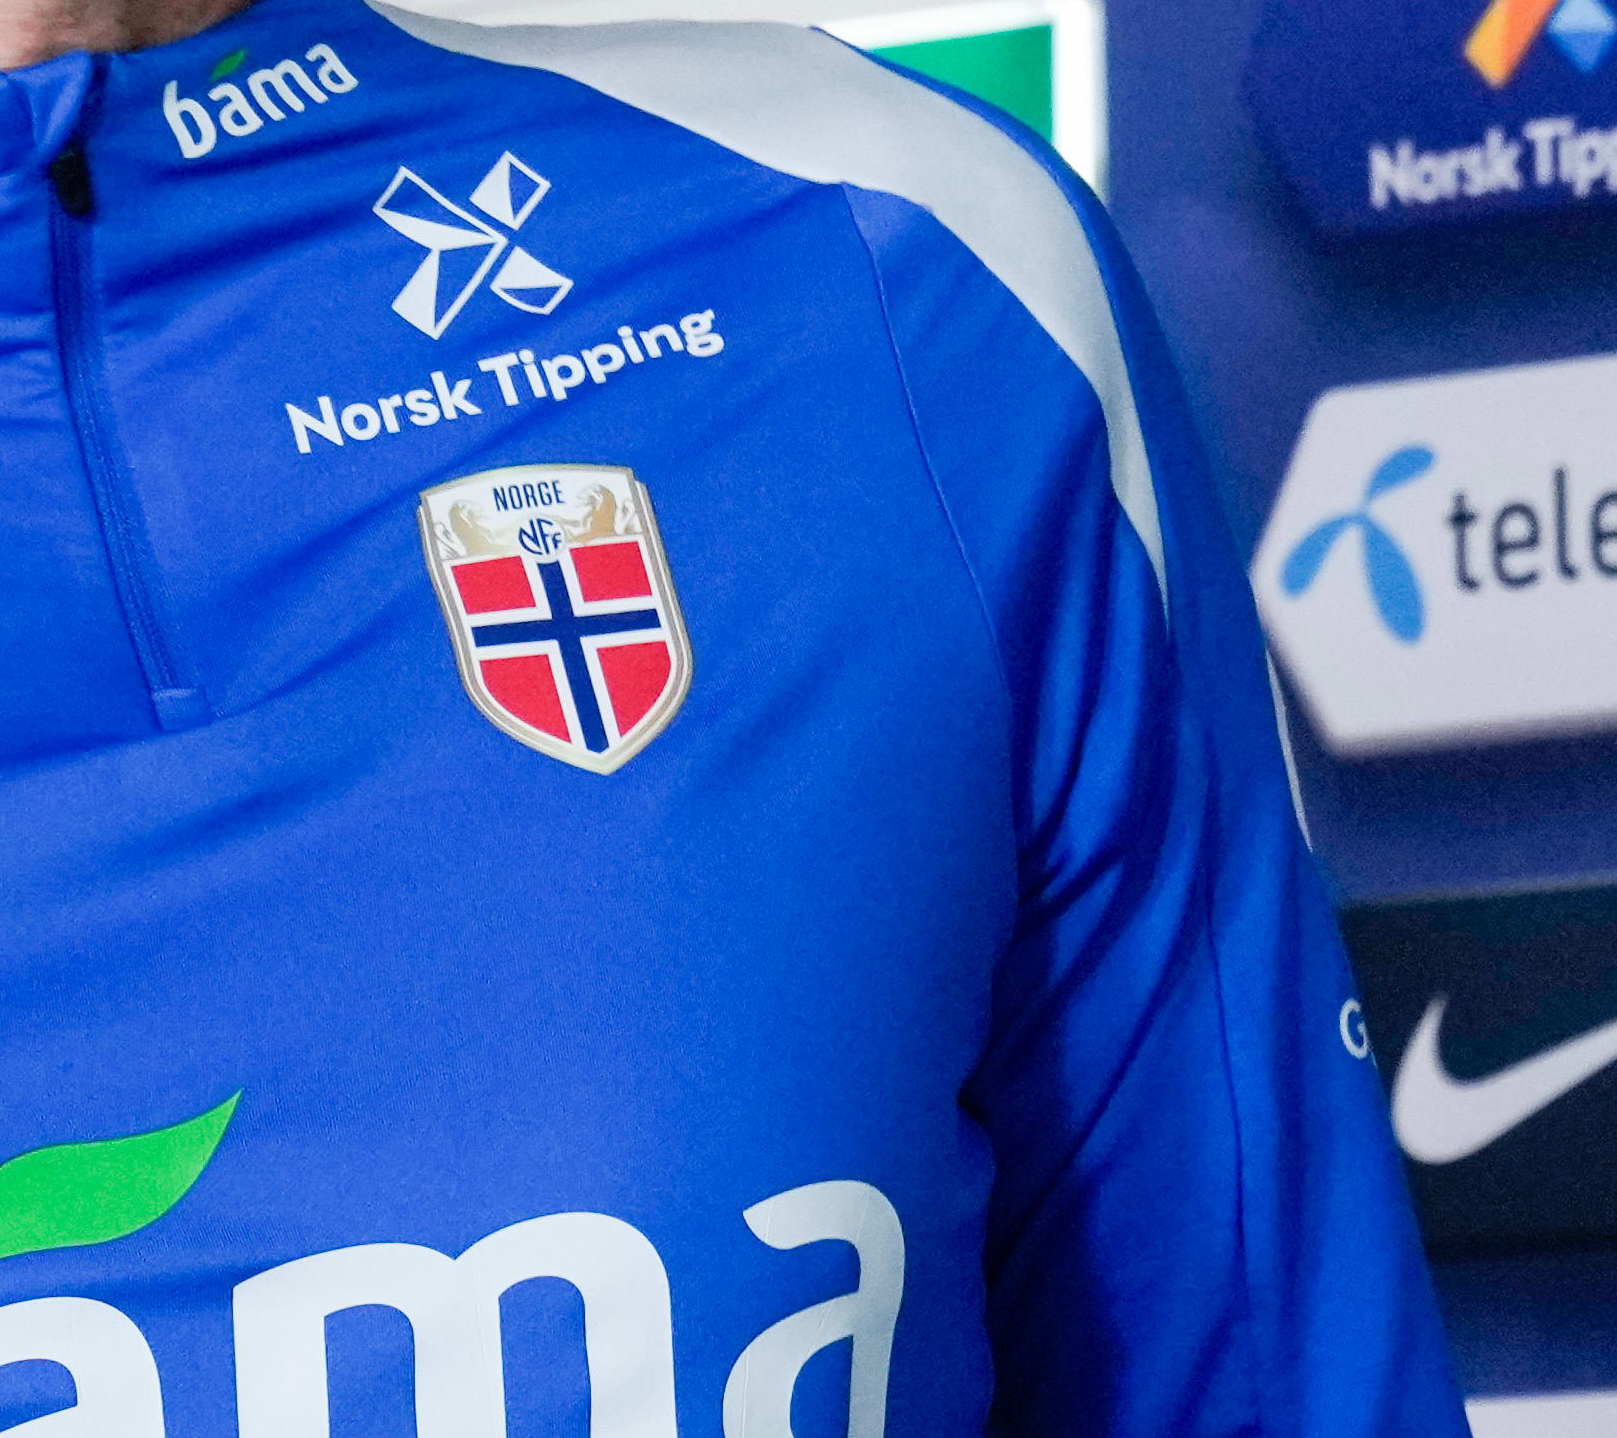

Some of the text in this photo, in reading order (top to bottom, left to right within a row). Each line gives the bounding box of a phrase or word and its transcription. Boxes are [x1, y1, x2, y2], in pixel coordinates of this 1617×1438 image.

[163, 42, 360, 160] bama
[1369, 129, 1523, 210] Norsk
[285, 308, 726, 455] Norsk Tipping
[492, 479, 566, 513] NORGE
